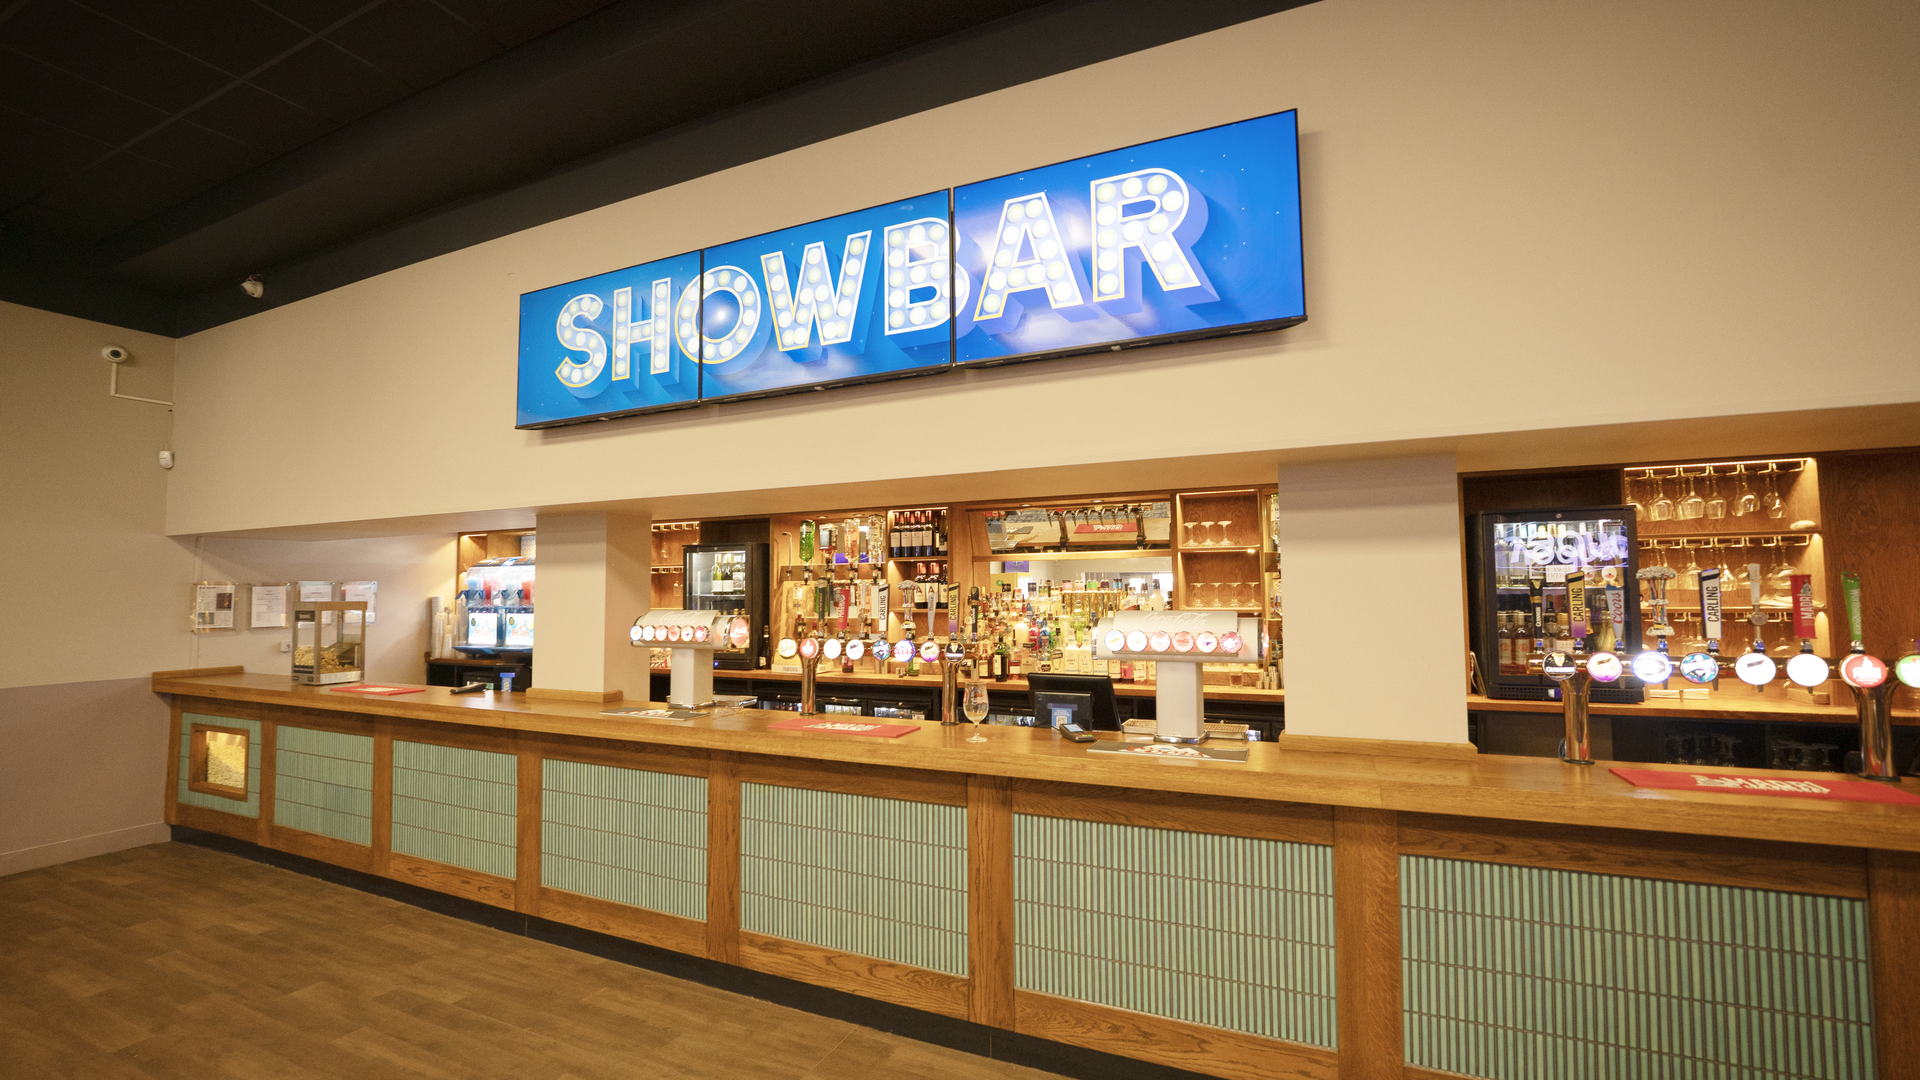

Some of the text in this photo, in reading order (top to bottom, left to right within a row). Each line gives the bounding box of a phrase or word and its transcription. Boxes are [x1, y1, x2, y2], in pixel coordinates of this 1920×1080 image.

[554, 168, 1201, 389] SHOWBAR
[879, 594, 887, 621] CARLING
[949, 594, 957, 621] CARLING
[1571, 587, 1585, 622] CARLING
[1611, 592, 1623, 624] Coors
[1705, 586, 1720, 622] CARLING
[1142, 612, 1212, 629] Coca-Cola
